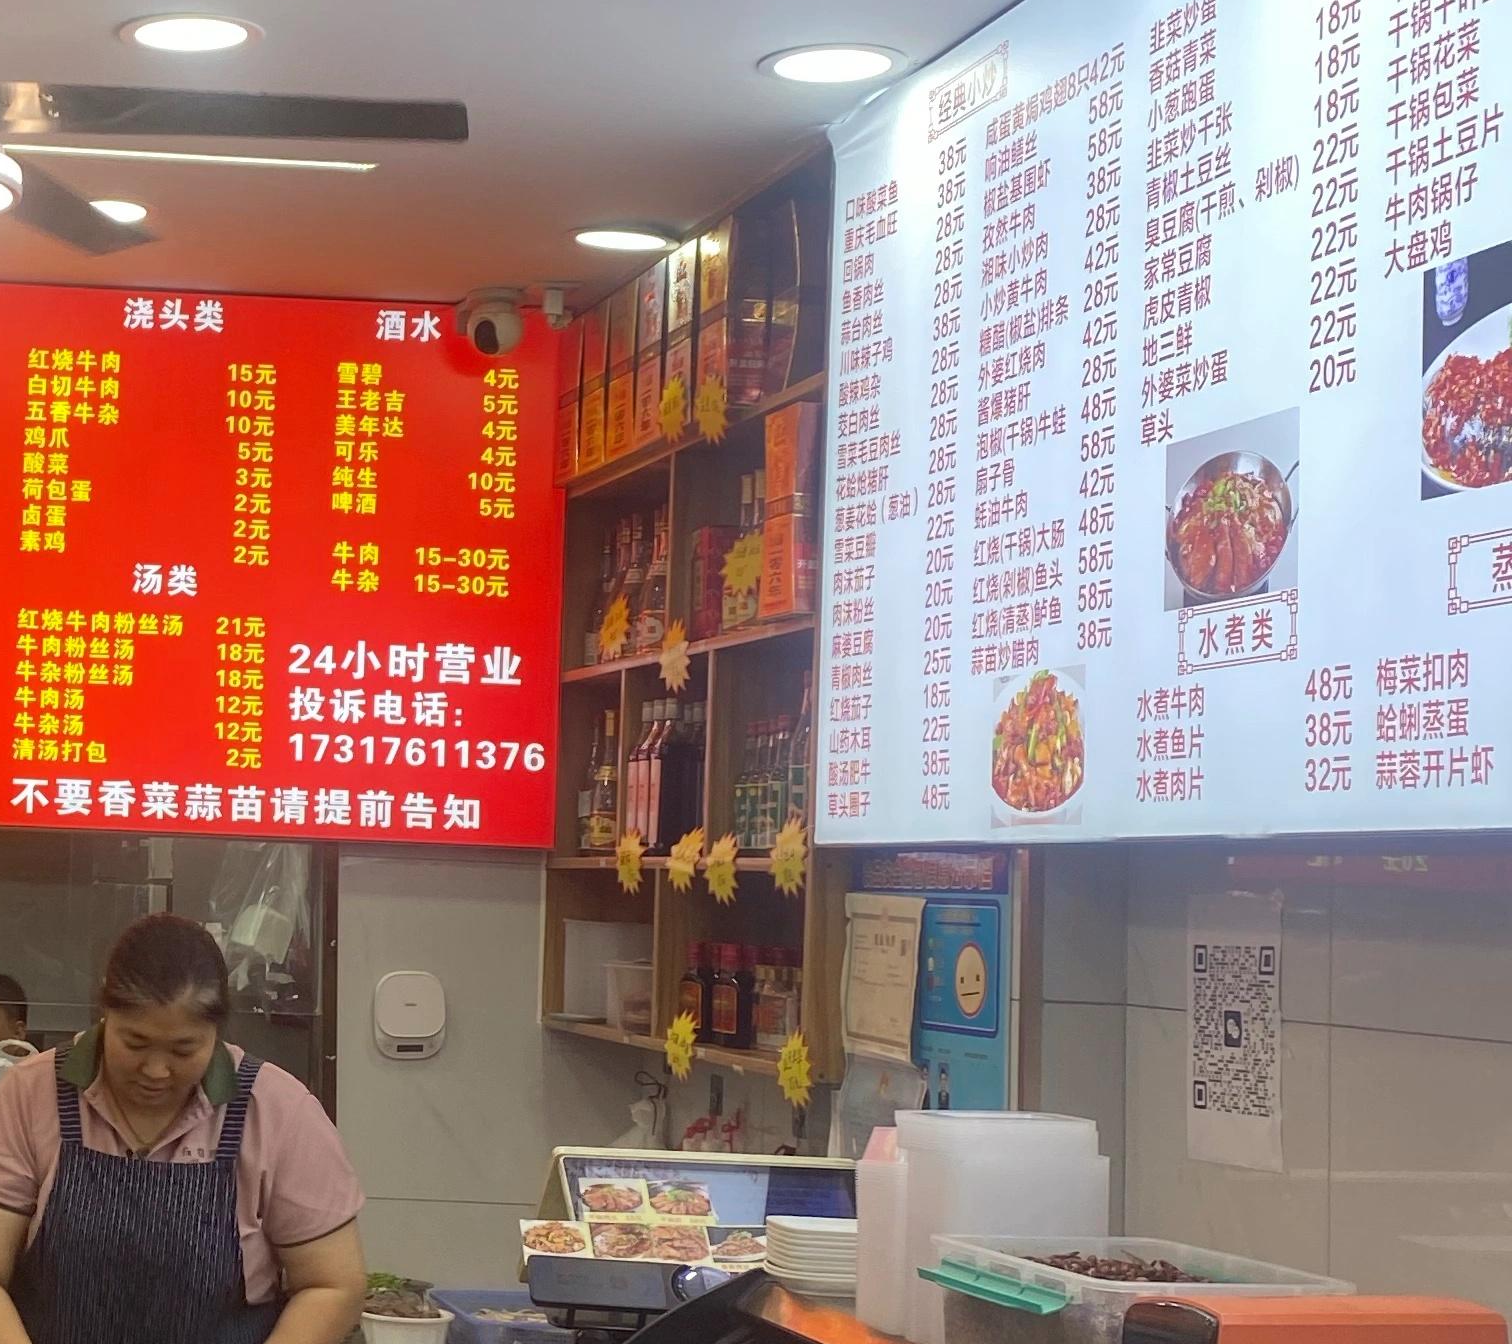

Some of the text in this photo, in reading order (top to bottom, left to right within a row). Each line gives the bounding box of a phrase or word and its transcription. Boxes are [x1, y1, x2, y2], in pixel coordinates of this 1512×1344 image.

[1090, 43, 1125, 85] 42元
[1149, 31, 1216, 94] 香菇青菜
[1387, 21, 1480, 90] 干锅花菜
[1386, 68, 1480, 136] 干锅包菜
[1385, 108, 1504, 183] 干锅土豆片
[984, 160, 1051, 219] 椒盐基围虾
[1145, 146, 1231, 212] 青椒土豆丝
[1384, 163, 1478, 228] 牛肉锅仔
[844, 252, 874, 282] 回锅肉
[981, 232, 1048, 288] 湘味小炒肉
[1144, 235, 1212, 290] 家常豆腐
[1384, 220, 1452, 279] 大盘鸡
[842, 278, 884, 314] 鱼香肉丝
[980, 268, 1047, 321] 小炒黄牛肉
[1143, 275, 1211, 330] 虎皮青椒
[124, 297, 223, 333] 浇头类
[376, 310, 441, 342] 酒水
[28, 348, 120, 373] 红烧牛肉
[1142, 320, 1192, 367] 地三鲜
[28, 374, 119, 399] 白切牛肉
[337, 362, 382, 385] 雪碧
[1142, 351, 1228, 409] 外婆菜炒蛋
[1309, 348, 1356, 393] 20元
[25, 400, 119, 425] 五香牛杂
[336, 389, 518, 415] 王老吉 5元
[335, 414, 404, 437] 美年达
[1080, 425, 1115, 461] 58元
[1141, 410, 1174, 447] 草头
[24, 426, 273, 462] 鸡爪 5元
[334, 440, 378, 462] 可乐
[23, 452, 68, 475] 酸菜
[332, 466, 515, 492] 纯生 10元
[22, 478, 271, 514] 荷包蛋 2元
[332, 491, 376, 514] 啤酒
[974, 490, 1028, 529] 蚝油牛肉
[22, 503, 66, 527] 卤蛋
[20, 529, 65, 553] 素鸡
[332, 541, 509, 570] 牛肉 15-30元
[133, 563, 197, 596] 汤类
[331, 568, 508, 597] 牛杂 15-30元
[17, 608, 265, 637] 红烧牛肉粉丝汤 21元
[1199, 609, 1273, 658] 水煮类
[16, 634, 134, 660] 牛肉粉丝汤
[832, 629, 873, 658] 麻婆豆腐
[924, 647, 951, 675] 25元
[15, 660, 133, 686] 牛杂粉丝汤
[288, 642, 521, 685] 24小时营业
[832, 662, 872, 690] 青椒肉丝
[1376, 651, 1468, 695] 梅菜扣肉
[14, 686, 263, 716] 牛肉汤 12元
[1305, 664, 1352, 702] 48元
[289, 687, 462, 727] 投诉电话:
[831, 694, 872, 721] 红烧茄子
[1137, 683, 1204, 722] 水煮牛肉
[14, 712, 84, 736] 牛杂汤
[830, 727, 871, 754] 山药木耳
[1305, 710, 1352, 747] 38元
[12, 738, 107, 763] 清汤打包
[289, 733, 545, 771] 17317611376
[1136, 724, 1204, 762] 水煮鱼片
[1136, 766, 1204, 802] 水煮肉片
[1305, 756, 1351, 792] 32元
[10, 778, 480, 830] 不要香菜蒜苗请提前告知
